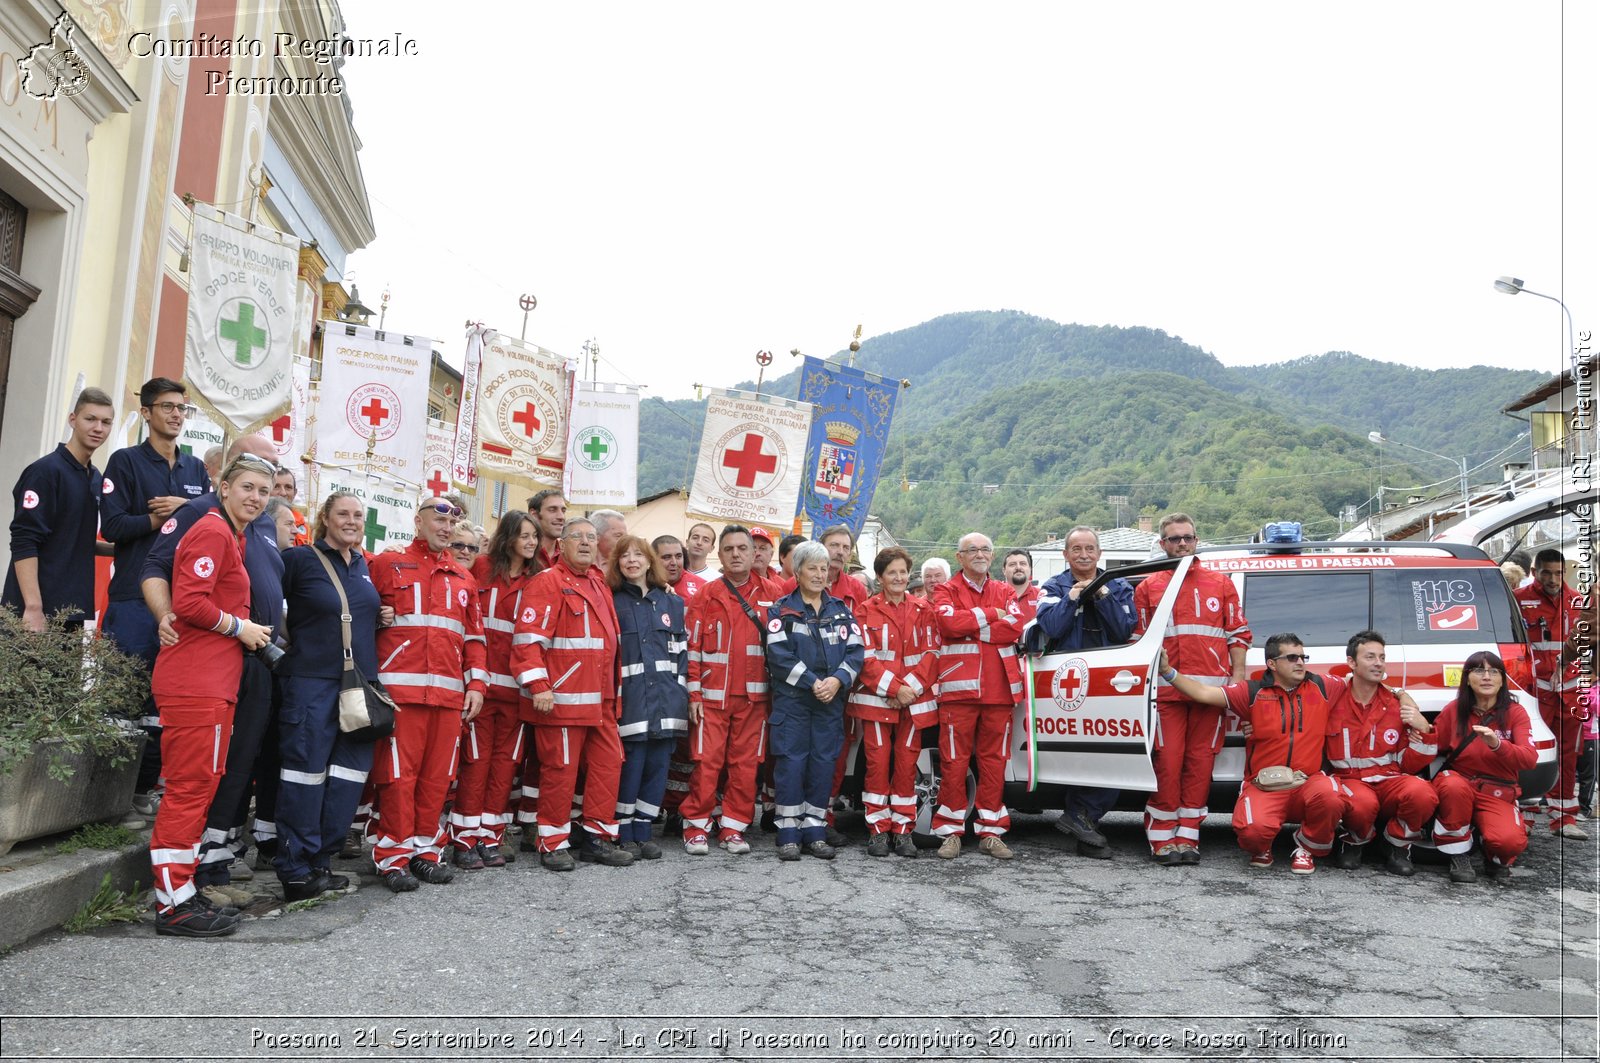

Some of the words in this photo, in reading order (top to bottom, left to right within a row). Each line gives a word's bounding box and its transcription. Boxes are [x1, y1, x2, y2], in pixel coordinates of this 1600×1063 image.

[199, 233, 240, 256] GRUPPO
[205, 271, 247, 297] CROCE
[252, 275, 286, 317] VERDE
[336, 347, 362, 358] CROCE
[363, 351, 388, 361] ROSSA
[390, 355, 419, 367] ITALIANA
[535, 360, 545, 369] DEL
[242, 369, 285, 400] PIEMONTE
[483, 373, 508, 399] CROCE
[508, 369, 539, 384] ROSSA
[509, 389, 518, 398] DI
[462, 400, 474, 430] ROSSA
[499, 395, 524, 446] CONVENZIONE
[544, 408, 554, 418] 22
[708, 406, 740, 419] CROCE
[741, 412, 770, 424] ROSSA
[771, 417, 808, 431] ITALIANA
[767, 408, 777, 416] DEL
[578, 428, 595, 441] CROCE
[597, 429, 613, 442] VERDE
[717, 423, 761, 448] CONVENZIONE
[769, 430, 786, 457] GINEVRA
[456, 430, 470, 461] CROCE
[398, 459, 407, 467] DI
[481, 453, 525, 467] COMITATO
[583, 461, 608, 469] CAVOUR
[372, 493, 413, 510] ASSISTENZA
[706, 496, 766, 512] DELEGAZIONE
[768, 507, 778, 515] DI
[711, 506, 767, 521] DRONERO
[1200, 559, 1297, 571] ELEGAZIONE
[1301, 558, 1318, 568] DI
[1322, 557, 1395, 567] PAESANA
[1418, 580, 1475, 603] 118
[1412, 581, 1426, 631] PIEMONTE
[1055, 694, 1085, 710] PAESANA
[1082, 718, 1145, 737] ROSSA
